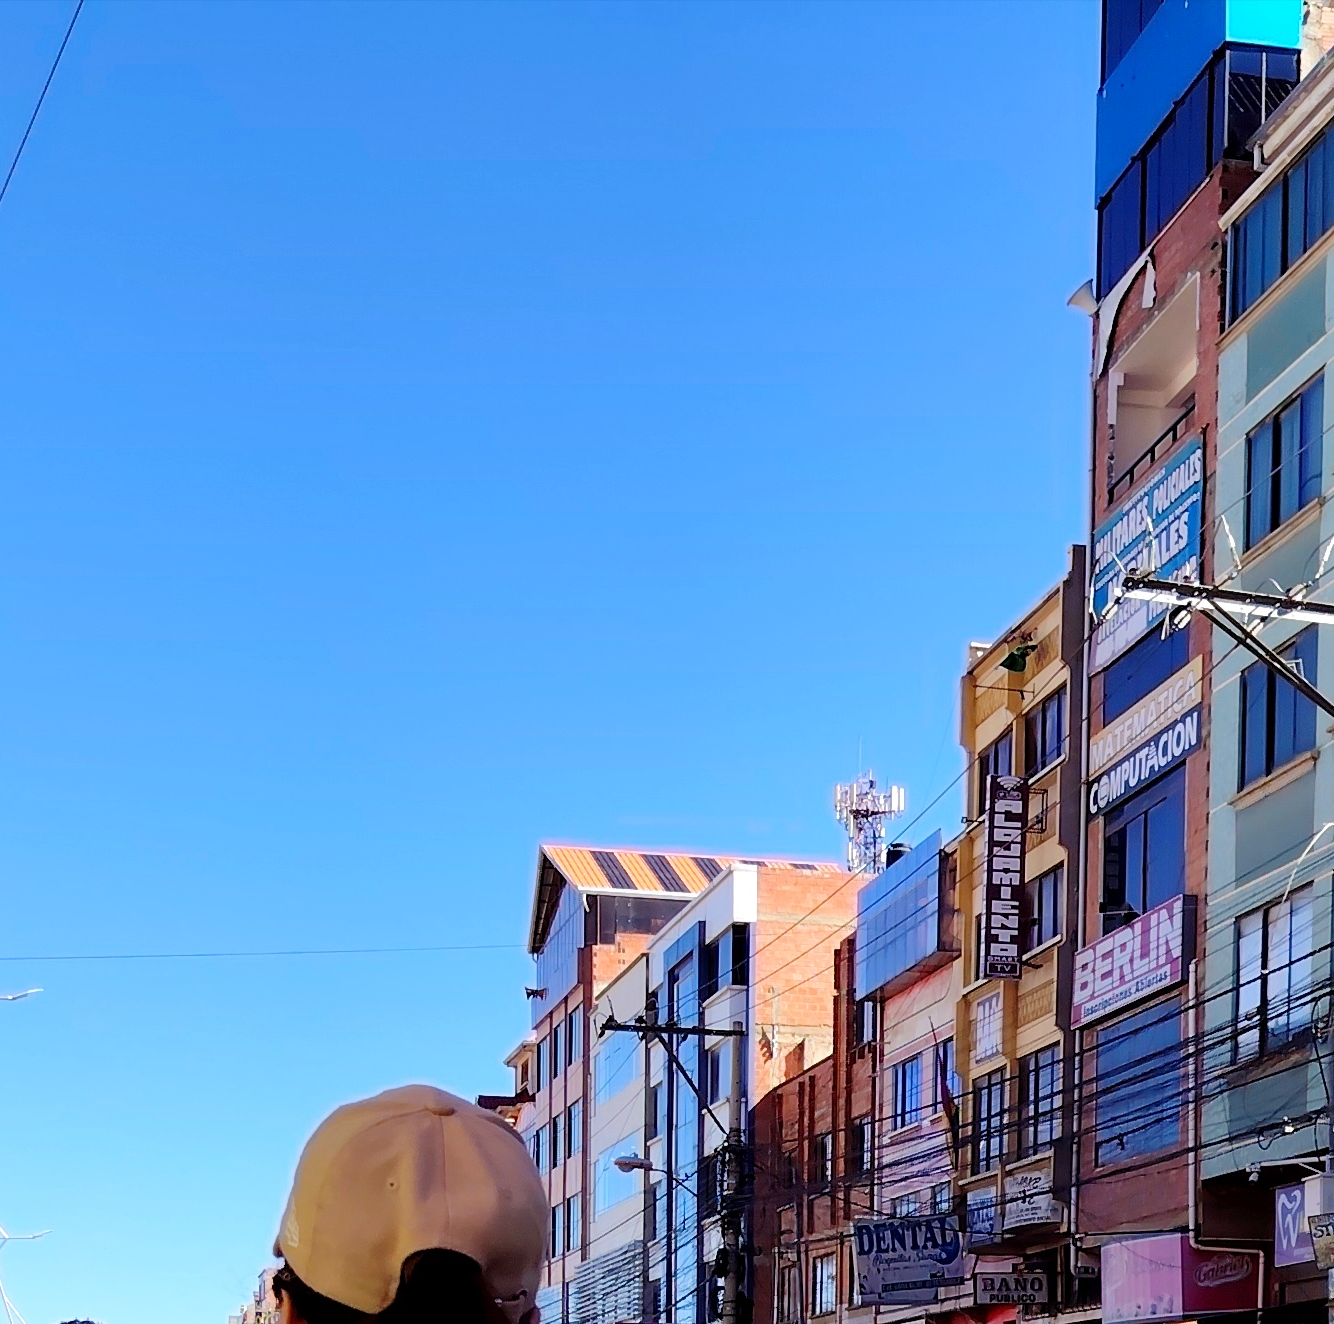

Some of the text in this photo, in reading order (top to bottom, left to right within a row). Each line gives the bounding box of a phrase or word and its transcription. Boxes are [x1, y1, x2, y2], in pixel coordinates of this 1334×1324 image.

[1089, 711, 1199, 815] COMPUTACIÓN
[990, 799, 1023, 957] ALOJAMIENTO
[995, 963, 1012, 973] TV
[1074, 898, 1184, 1003] BERLIN
[857, 1218, 956, 1257] DENTAL
